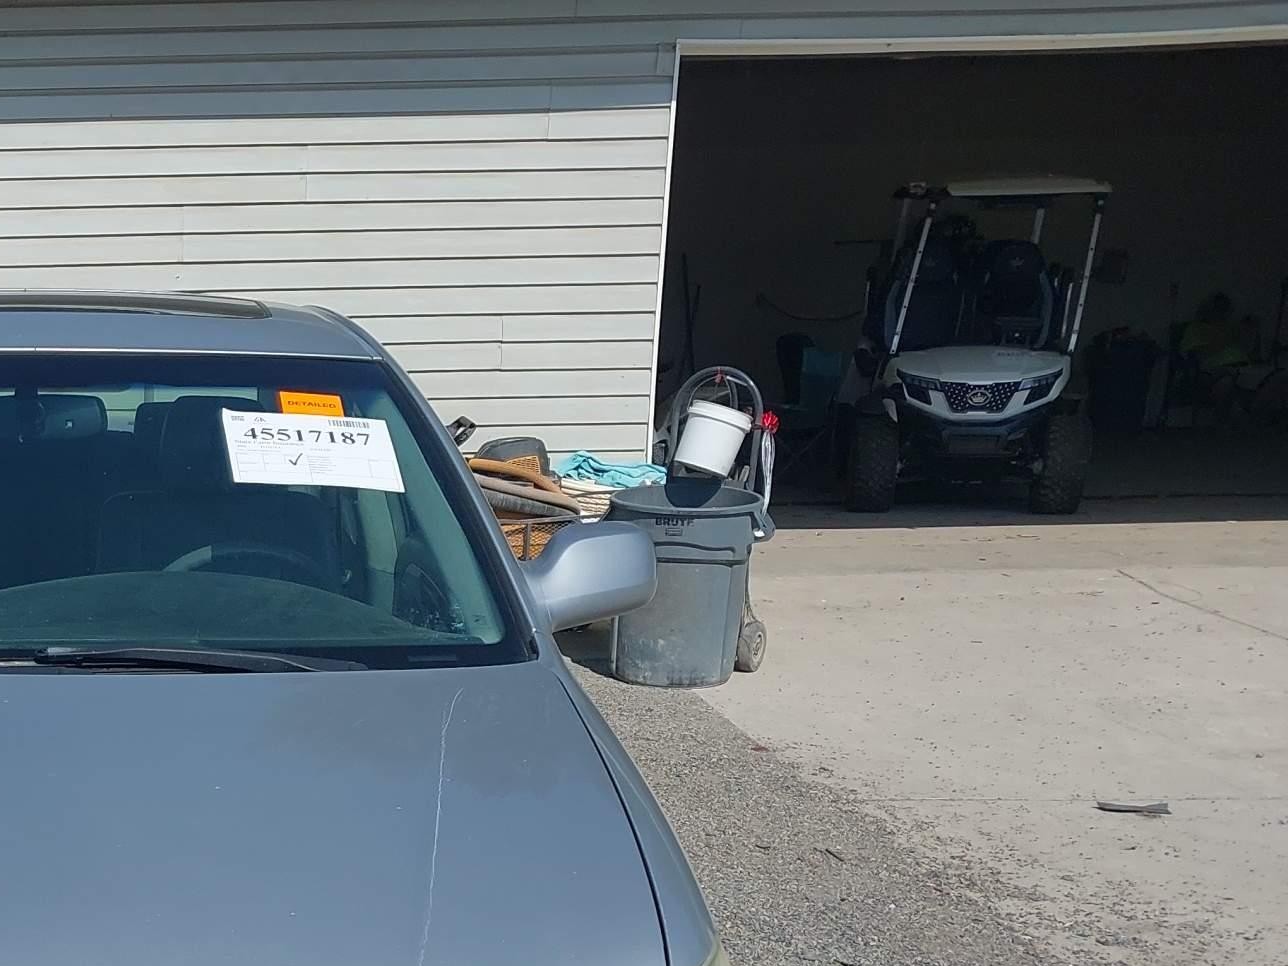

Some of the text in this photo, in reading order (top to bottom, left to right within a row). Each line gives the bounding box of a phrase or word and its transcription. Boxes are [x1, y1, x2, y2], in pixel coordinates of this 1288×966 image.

[287, 400, 337, 409] DETAILED
[243, 427, 370, 446] 45517187
[655, 516, 696, 527] BRUTE
